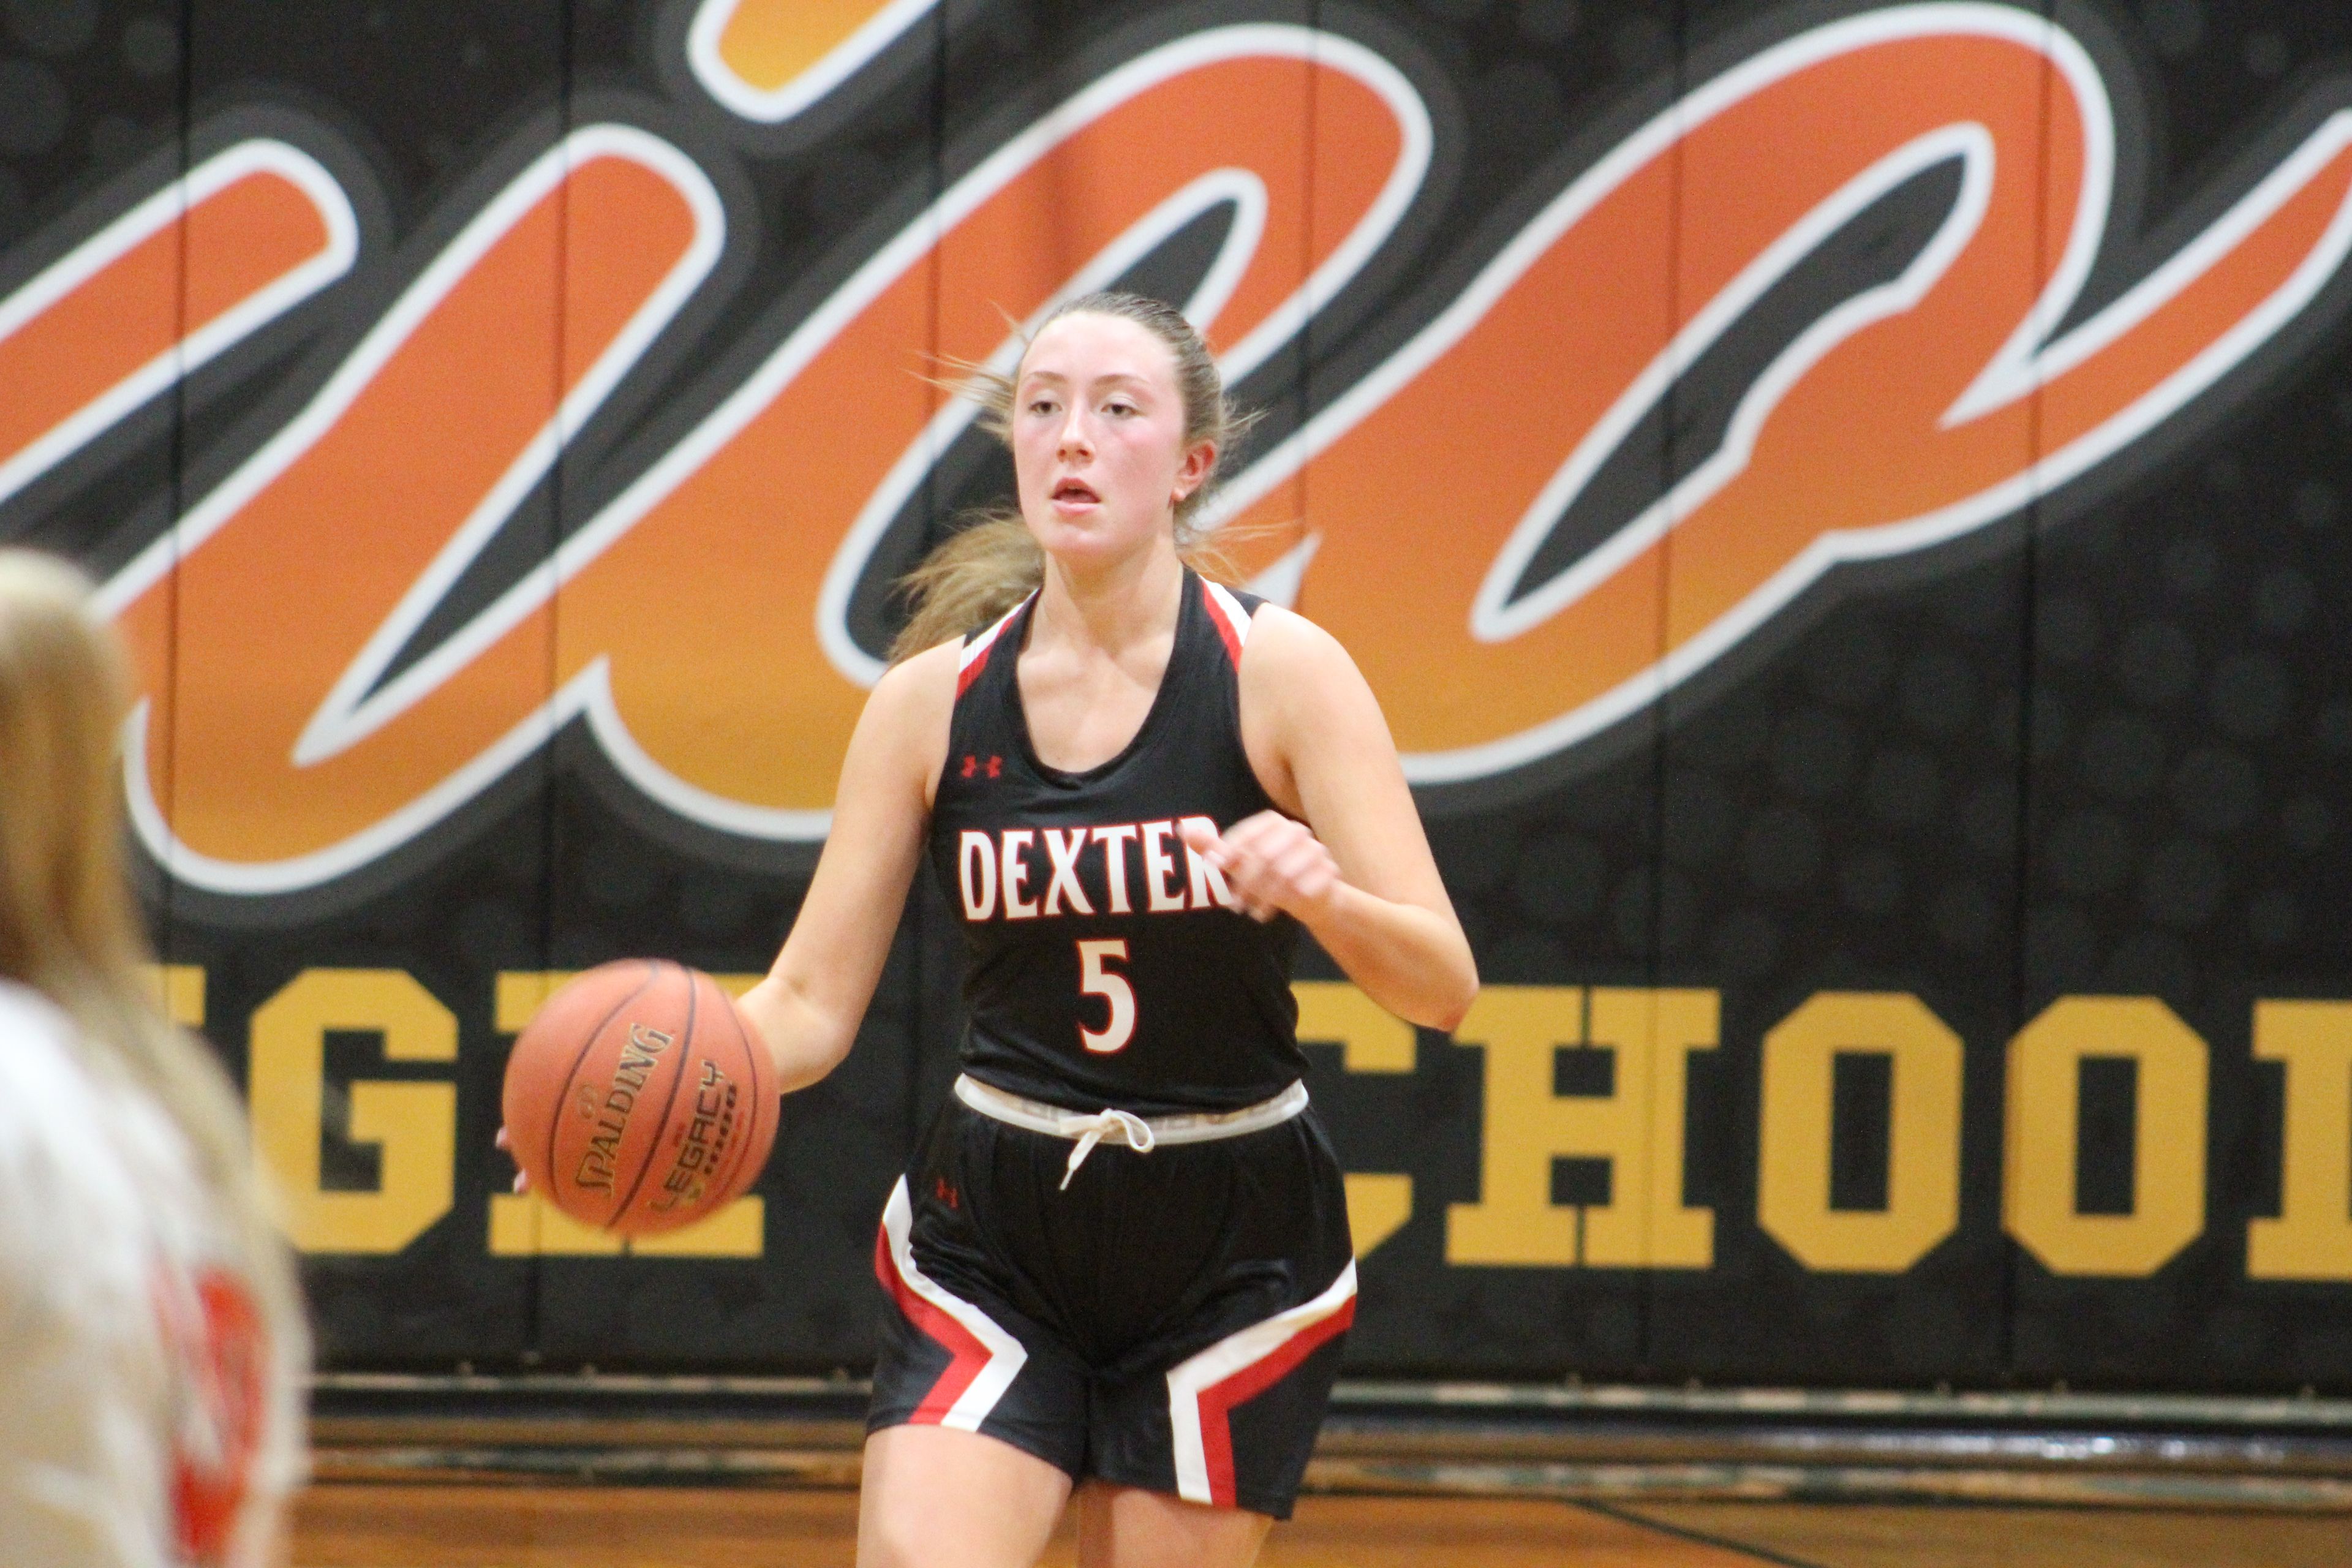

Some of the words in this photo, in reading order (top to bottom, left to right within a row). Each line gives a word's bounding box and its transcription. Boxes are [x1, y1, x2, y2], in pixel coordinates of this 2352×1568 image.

[959, 813, 1236, 921] DEXTER
[1075, 936, 1139, 1056] 5
[574, 1022, 675, 1199] SPALDING
[647, 1059, 725, 1214] LEGACY
